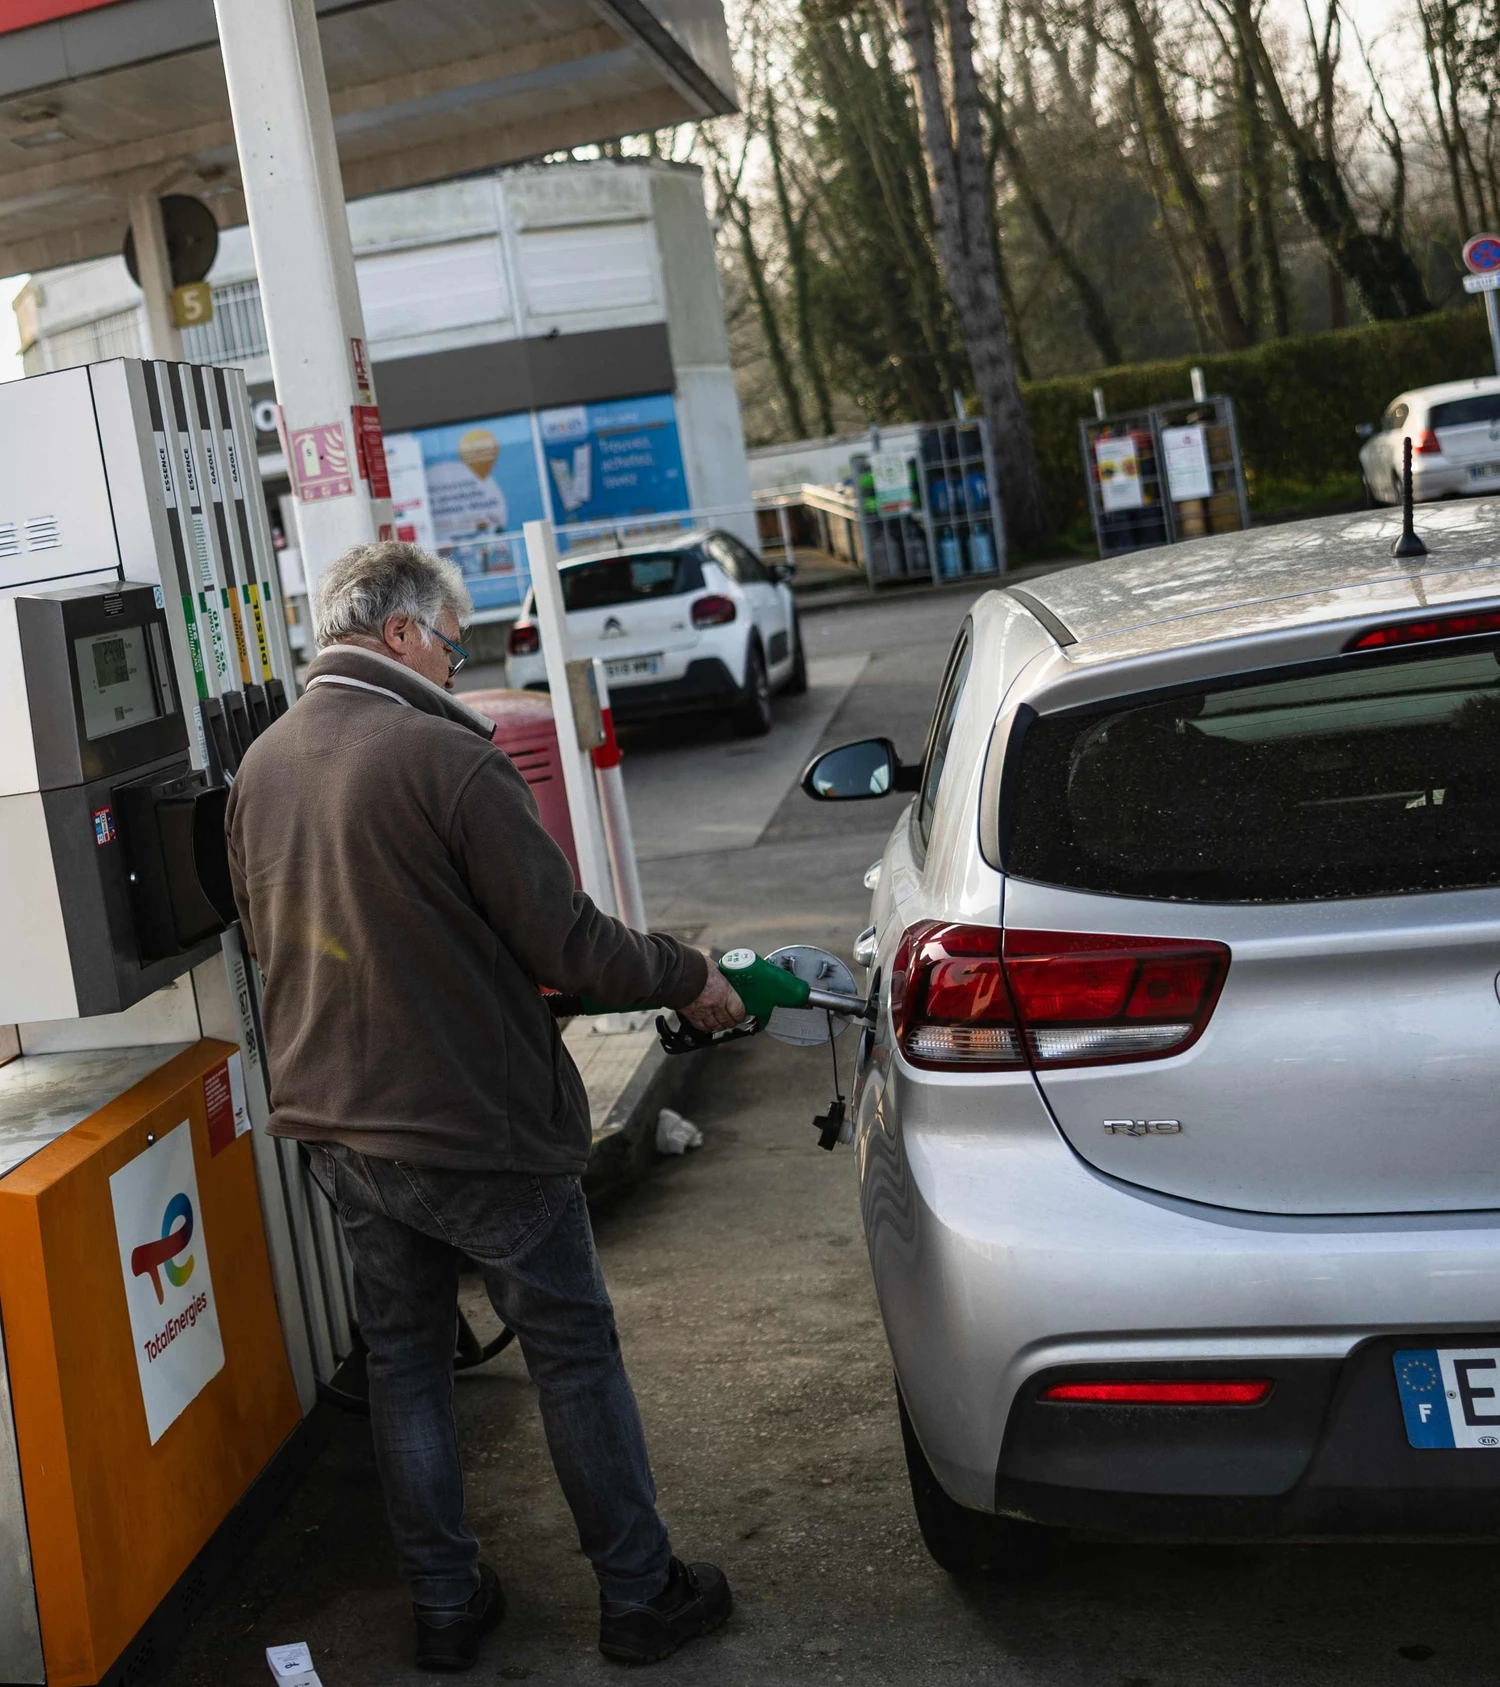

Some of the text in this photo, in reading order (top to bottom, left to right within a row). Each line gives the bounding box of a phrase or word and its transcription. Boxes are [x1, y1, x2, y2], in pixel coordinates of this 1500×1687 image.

[182, 289, 203, 320] 5
[159, 448, 171, 491] ESSENCE
[183, 448, 195, 490] ESSENCE
[207, 447, 217, 485] GAZOLE
[228, 446, 238, 483] GAZOLE
[253, 599, 268, 665] DIESEL
[1103, 1119, 1181, 1137] RIO
[144, 1292, 207, 1363] TotalEnergies
[1453, 1358, 1500, 1426] E
[1418, 1403, 1432, 1423] F
